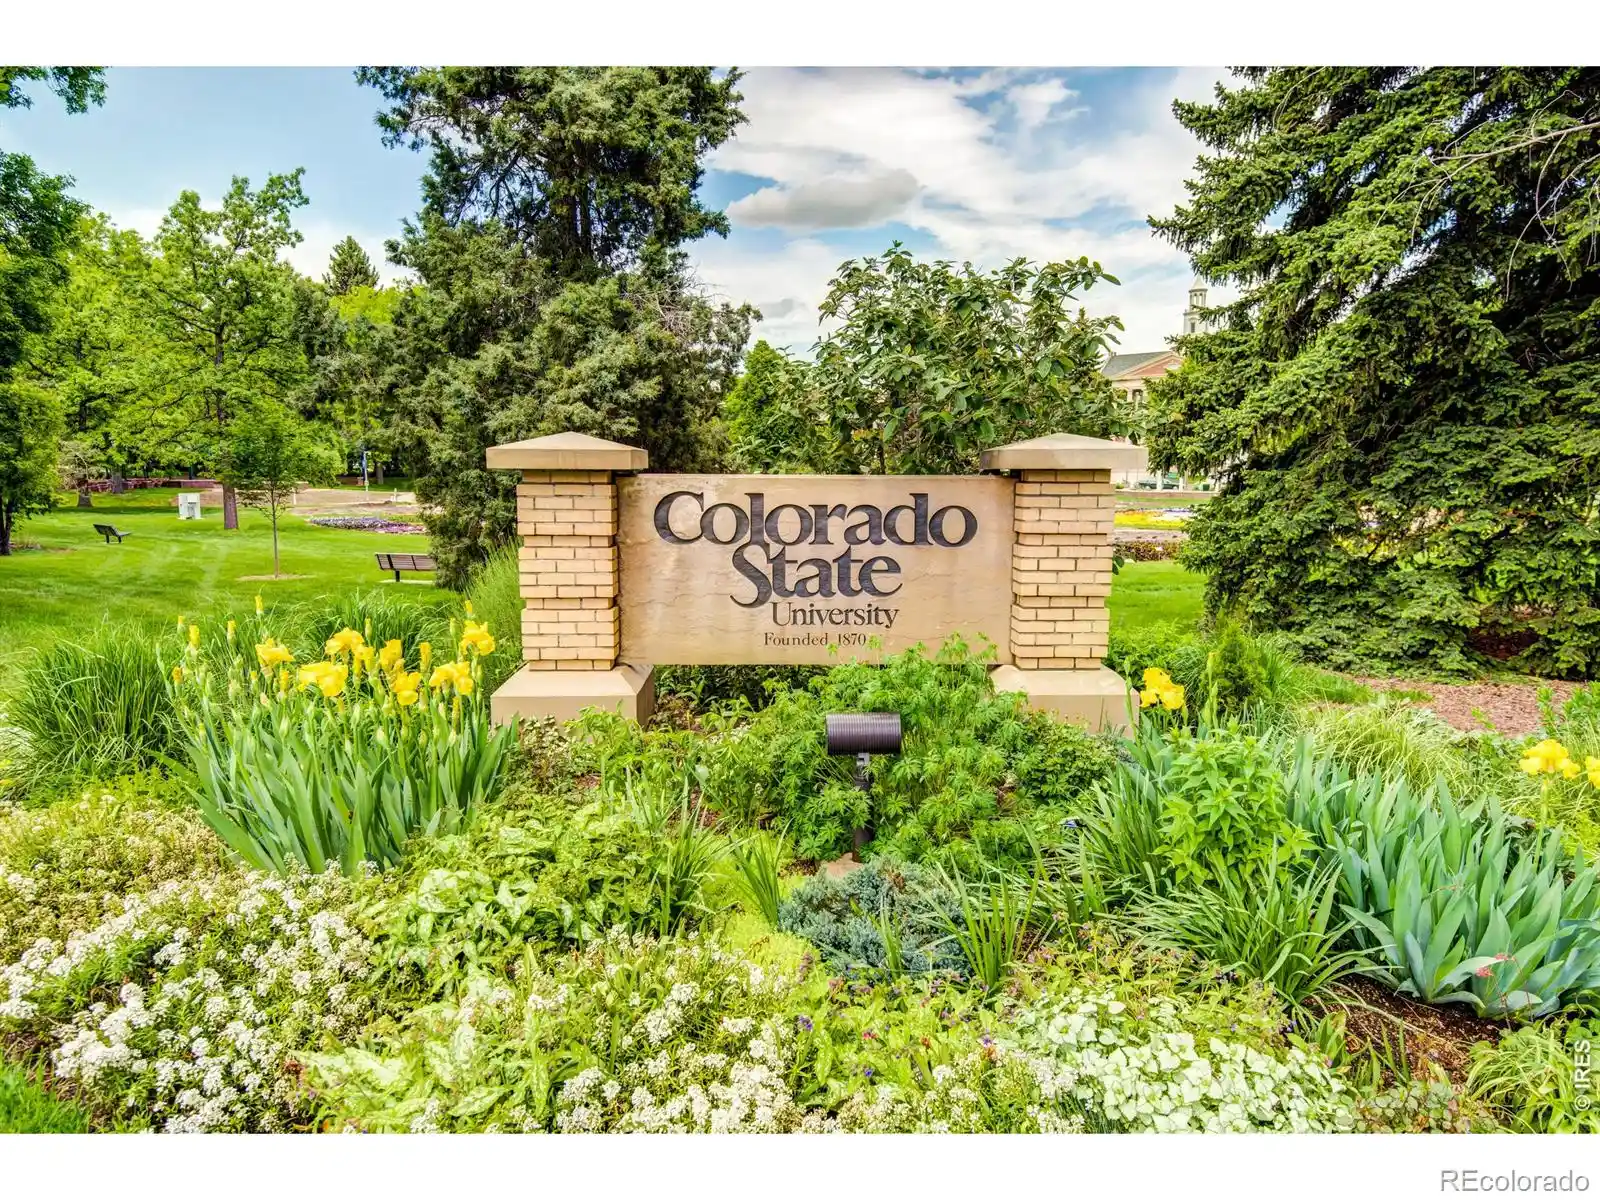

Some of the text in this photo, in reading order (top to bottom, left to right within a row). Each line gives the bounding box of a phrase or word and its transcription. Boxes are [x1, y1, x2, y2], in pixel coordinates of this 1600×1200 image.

[653, 490, 978, 548] Colorado
[730, 543, 903, 608] State
[771, 602, 900, 629] University
[764, 632, 866, 646] Founded 1870
